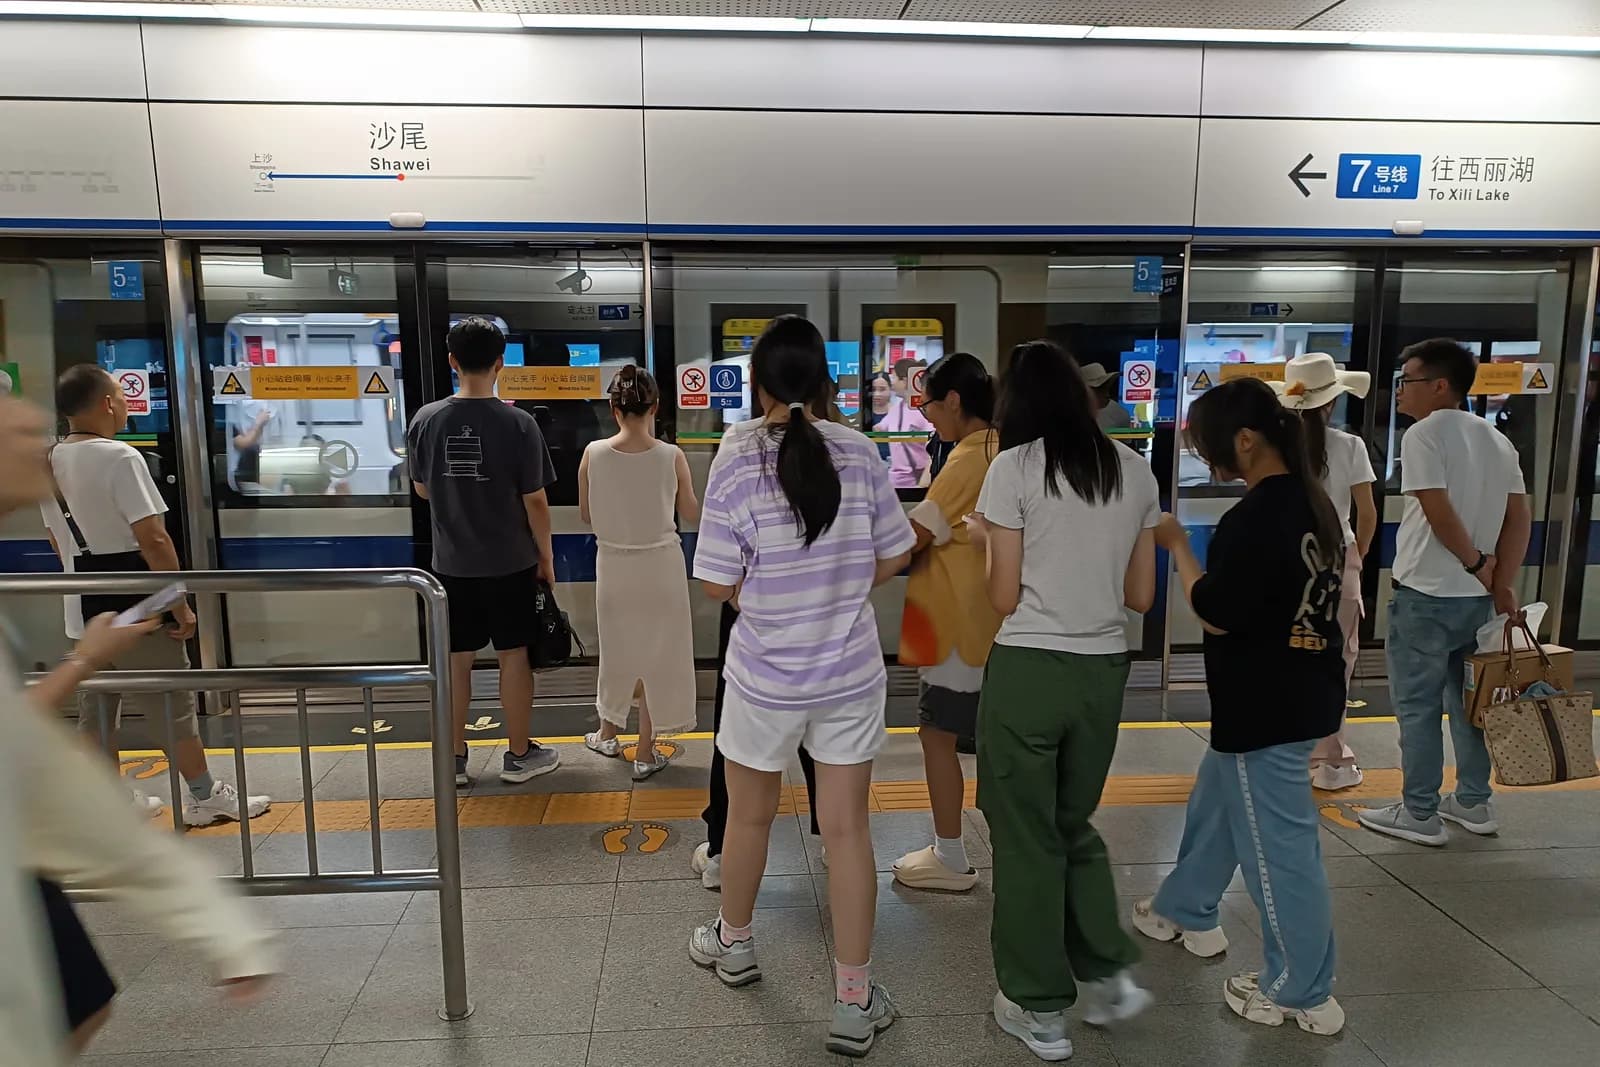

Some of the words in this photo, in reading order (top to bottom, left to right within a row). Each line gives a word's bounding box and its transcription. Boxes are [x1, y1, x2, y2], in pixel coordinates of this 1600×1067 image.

[369, 121, 428, 150] 沙尾
[370, 157, 430, 171] Shawei
[1431, 155, 1535, 184] 往西丽湖
[1350, 159, 1372, 193] 7
[1374, 165, 1409, 184] 号线
[1372, 184, 1392, 193] Line
[1392, 184, 1399, 193] 7
[1428, 188, 1445, 201] To
[1449, 188, 1473, 201] Xili
[1476, 188, 1511, 201] Lake
[113, 266, 126, 287] 5
[1137, 261, 1149, 281] 5
